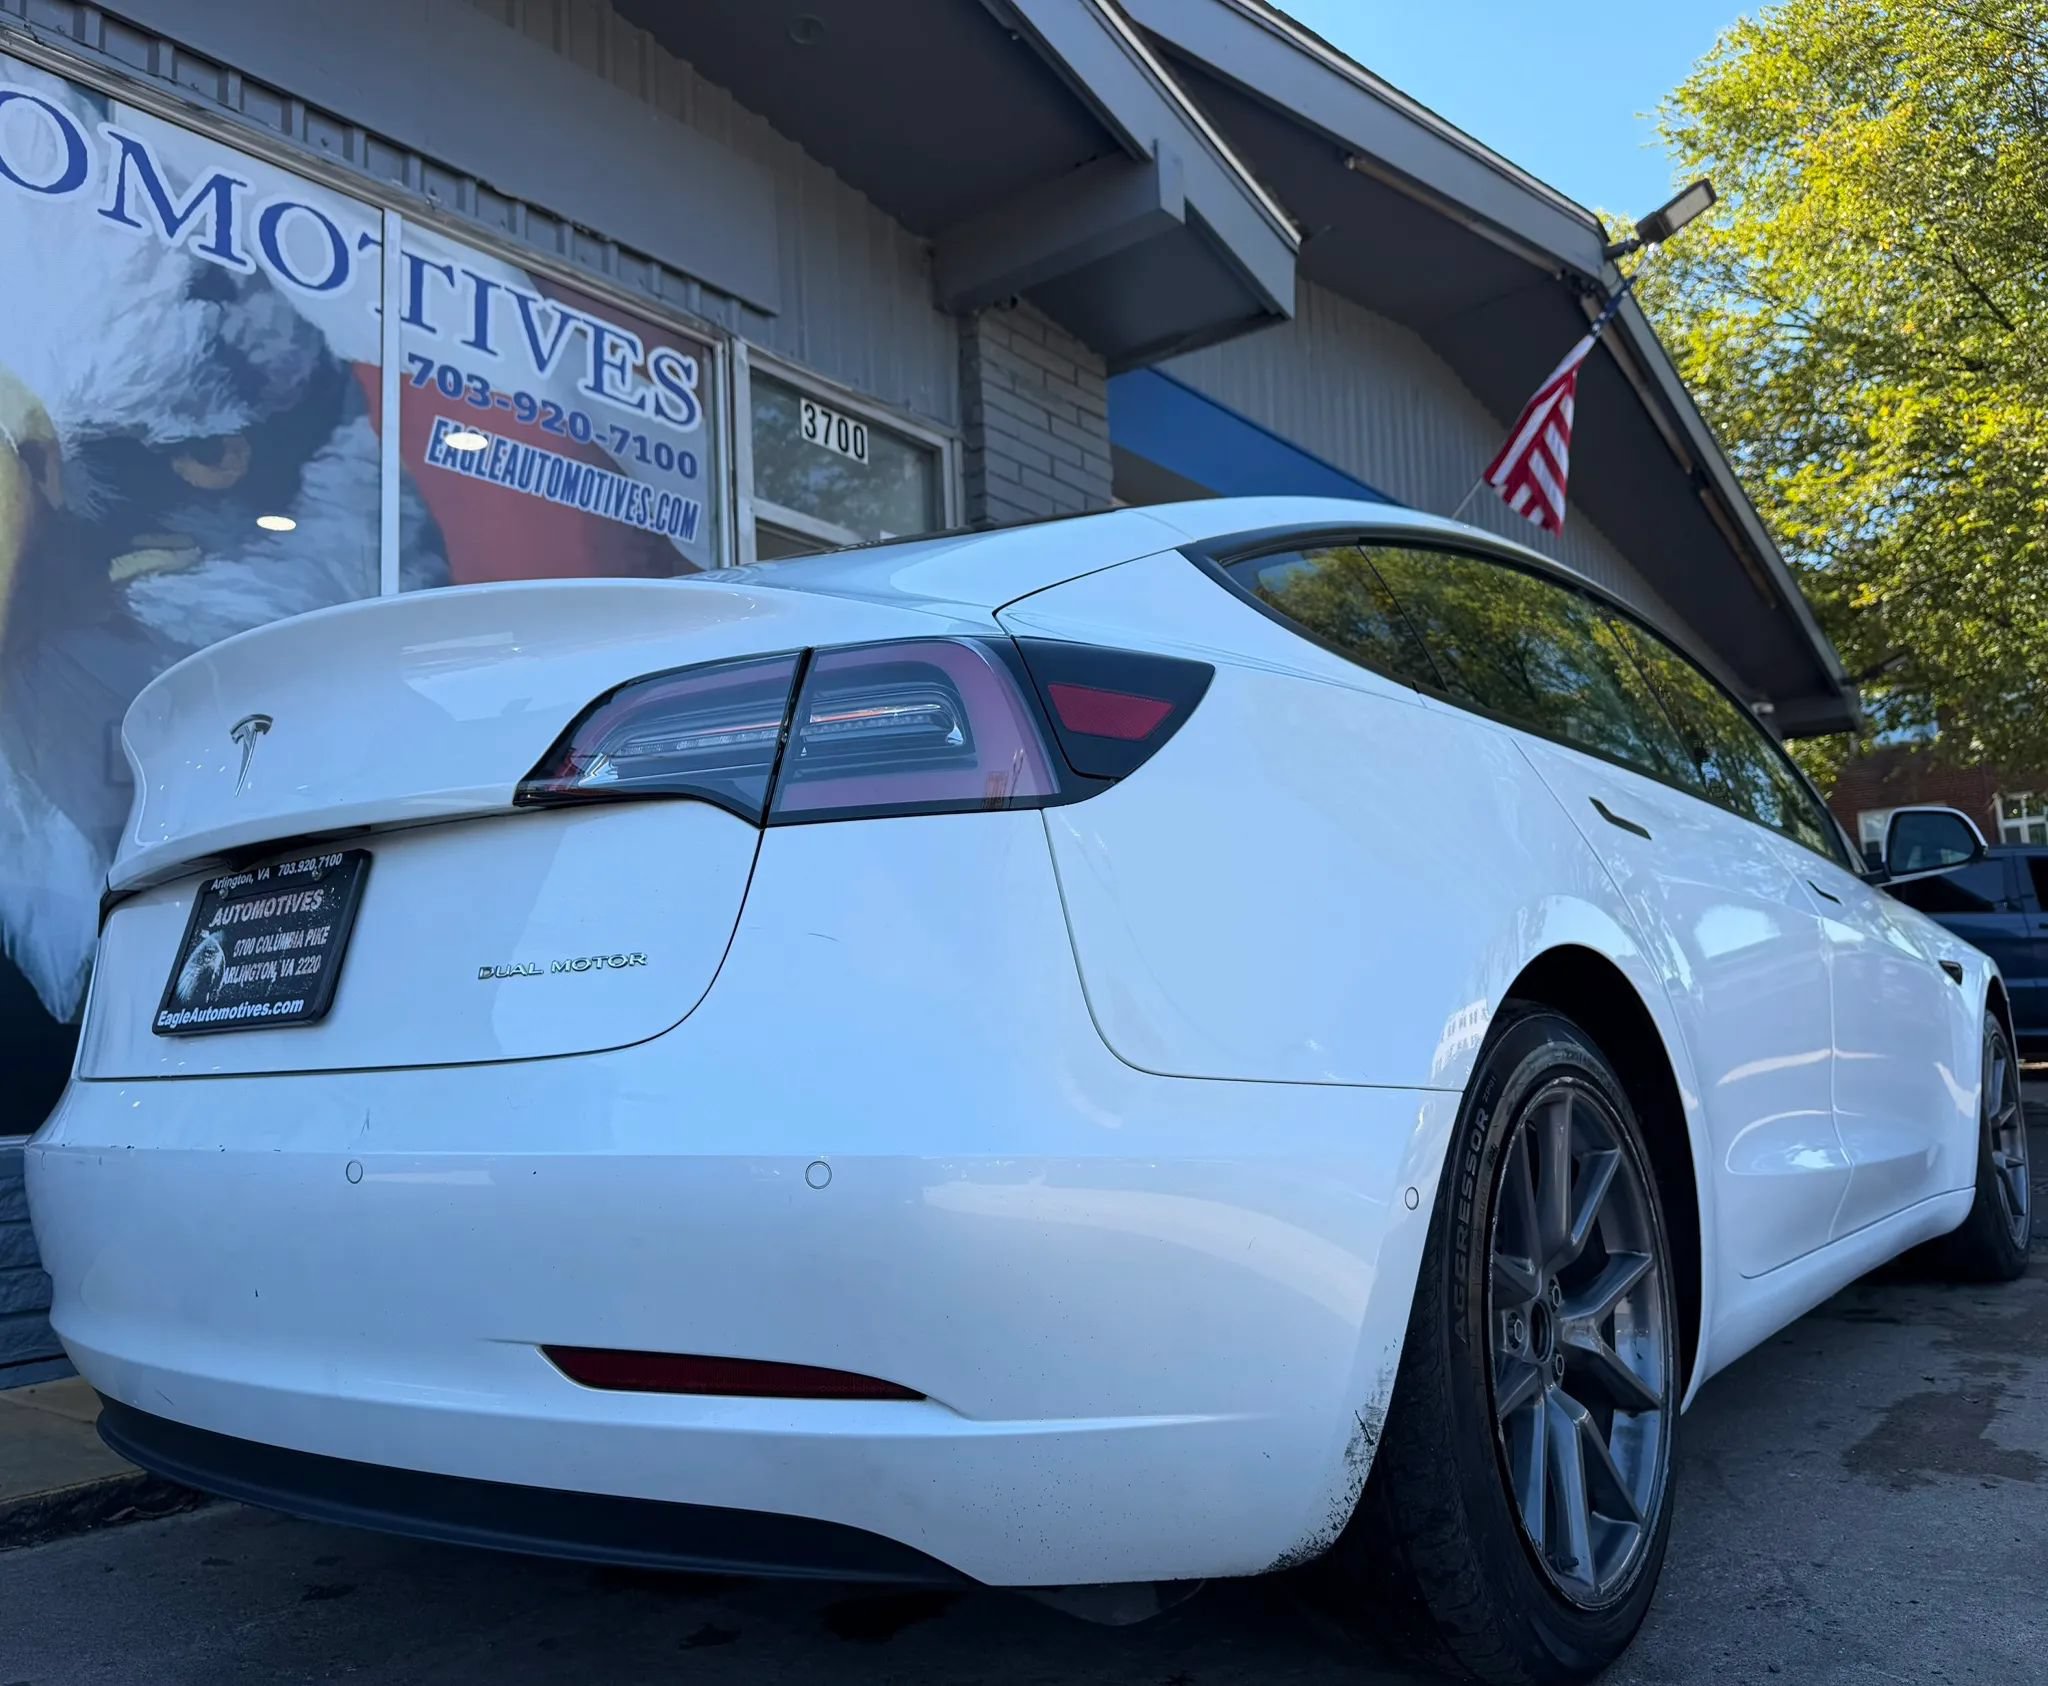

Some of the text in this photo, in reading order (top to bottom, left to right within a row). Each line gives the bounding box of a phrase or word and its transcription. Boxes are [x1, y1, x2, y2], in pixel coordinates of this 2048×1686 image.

[407, 352, 699, 480] 703-920-7100
[804, 403, 865, 460] 3700
[211, 853, 343, 890] Arlington, VA 703.920.7100
[209, 888, 324, 928] AUTOMOTIVES
[255, 929, 304, 954] COLUMBIA
[304, 925, 331, 947] PIKE
[280, 958, 295, 977] VA
[478, 953, 648, 980] DUAL MOTOR
[157, 999, 304, 1028] EagleAutomotives.com
[1453, 1107, 1488, 1344] AGGRESSOR
